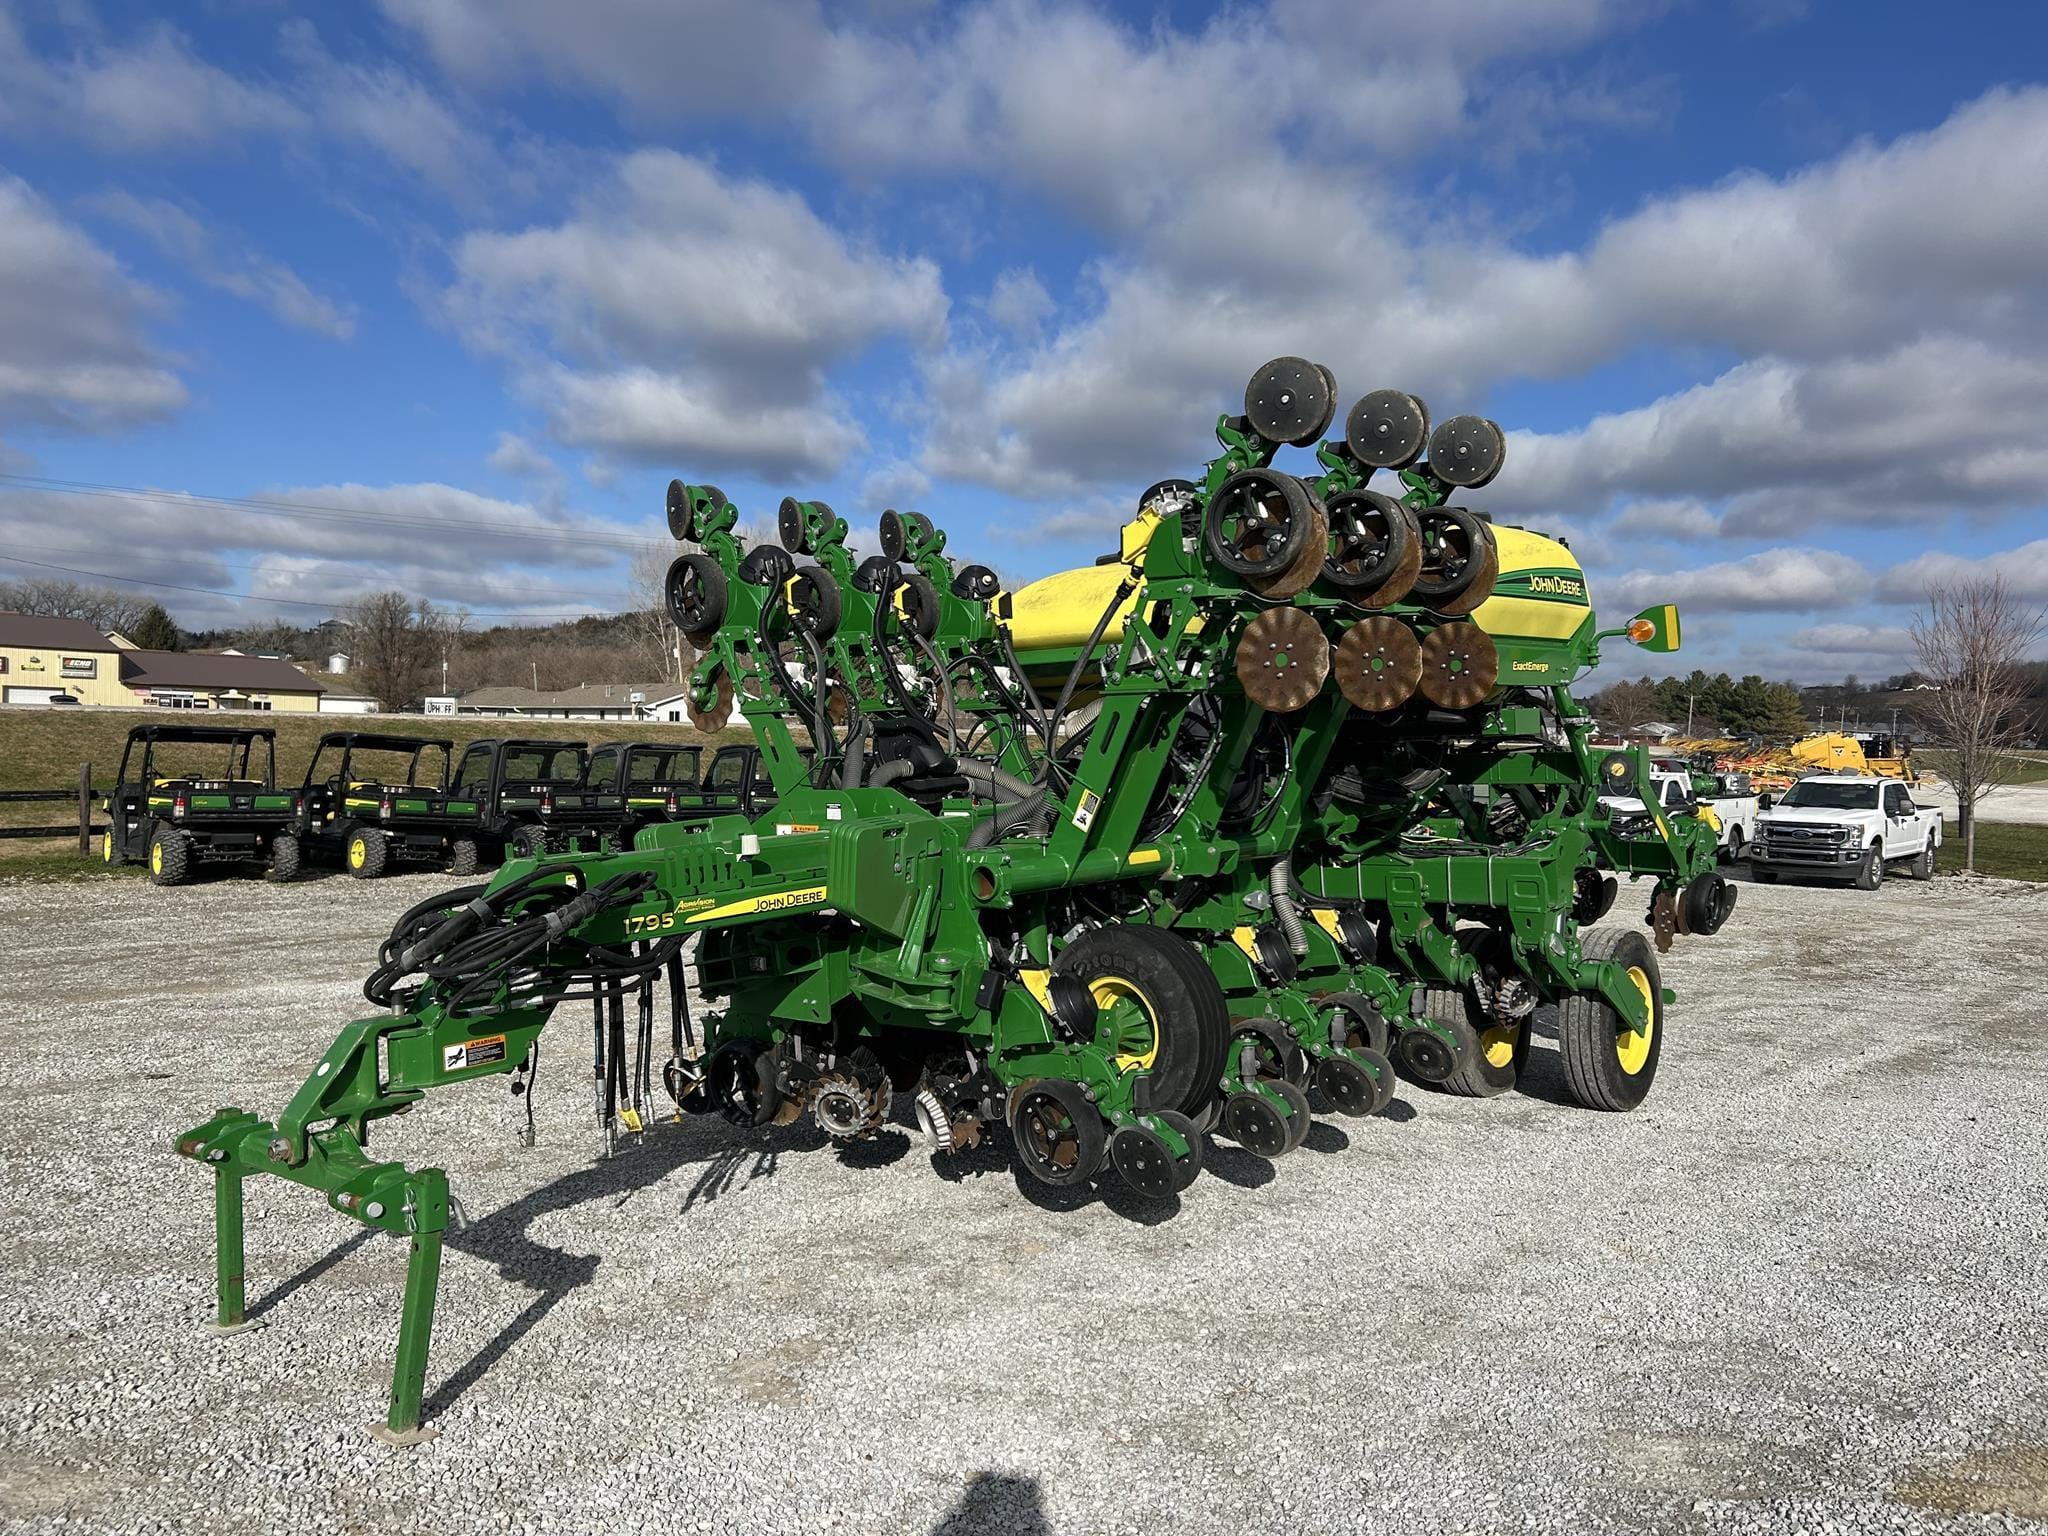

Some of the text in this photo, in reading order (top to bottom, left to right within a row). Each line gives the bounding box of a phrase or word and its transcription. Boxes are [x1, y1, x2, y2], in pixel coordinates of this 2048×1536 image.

[1529, 574, 1582, 596] JOHN DEERE
[1512, 661, 1549, 673] ExactEmerge
[754, 891, 823, 912] JOHN DEERE
[623, 912, 675, 935] 1795
